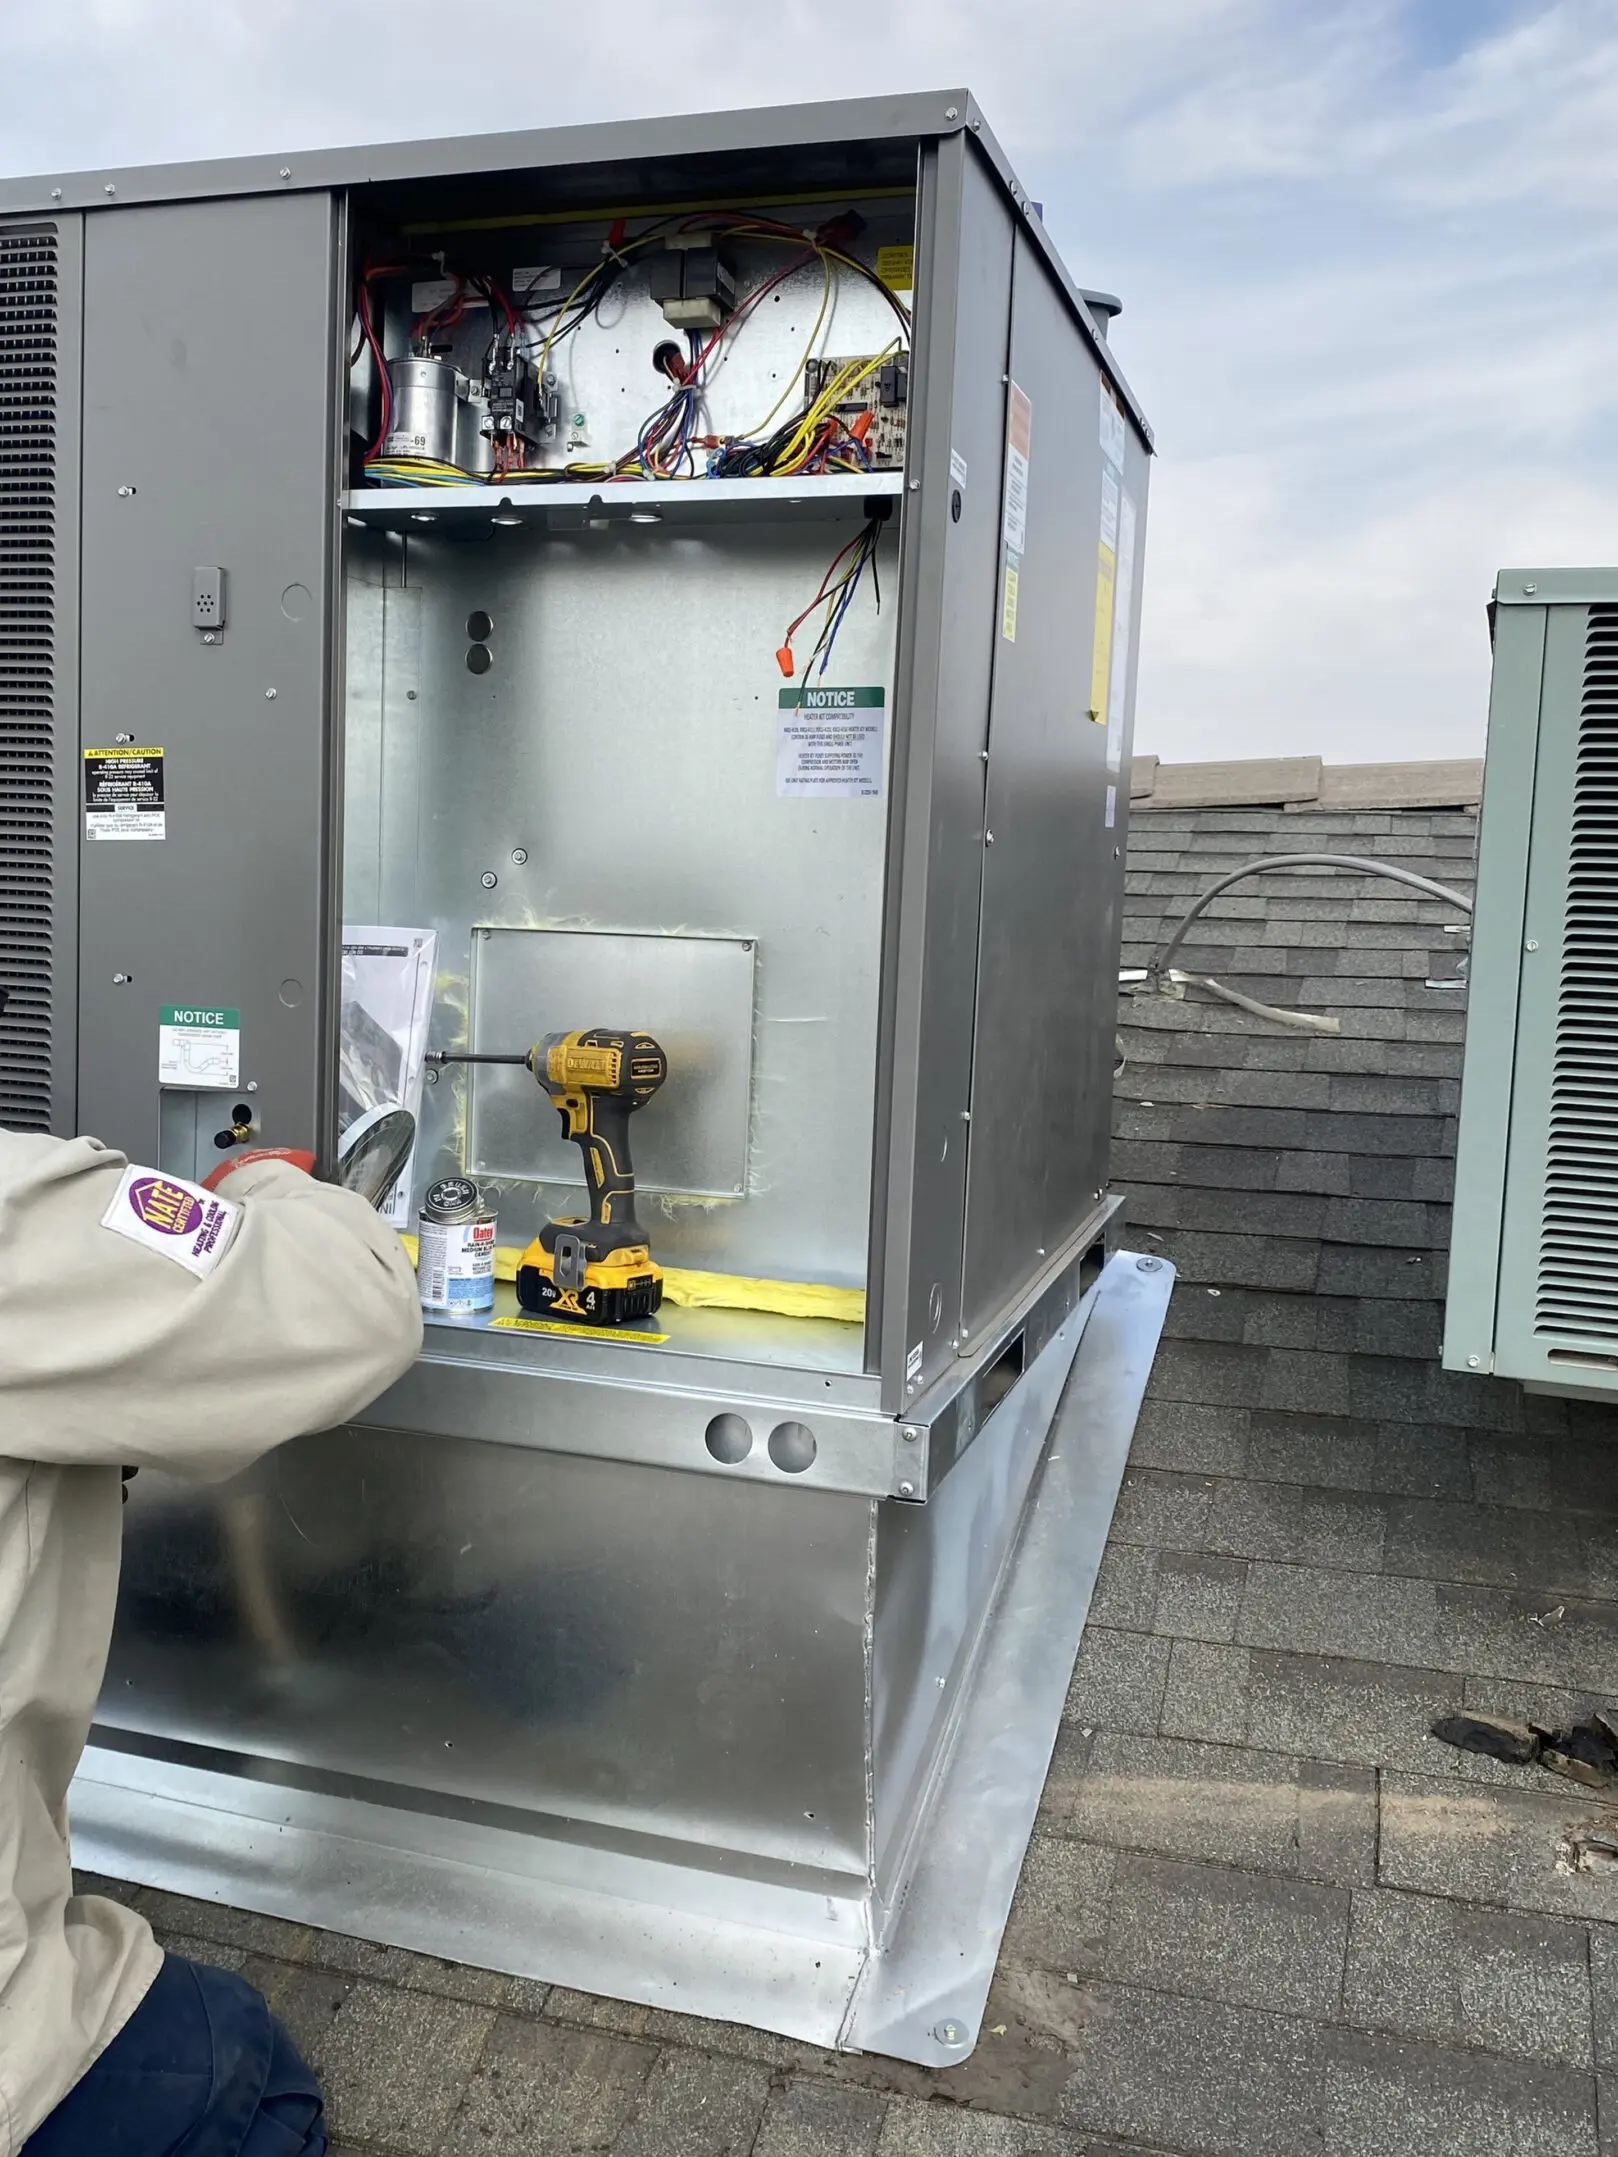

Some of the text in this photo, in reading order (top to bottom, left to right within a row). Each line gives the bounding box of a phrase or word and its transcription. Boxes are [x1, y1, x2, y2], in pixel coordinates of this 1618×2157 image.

[807, 691, 855, 707] NOTICE
[174, 1010, 224, 1024] NOTICE
[144, 1180, 184, 1230] NATE
[172, 1196, 195, 1234] CERTIFIED
[192, 1228, 209, 1257] HEATING
[204, 1210, 227, 1254] PROFESSIONAL
[474, 1227, 493, 1239] Oatey
[549, 1287, 587, 1315] XR
[586, 1291, 596, 1305] 4
